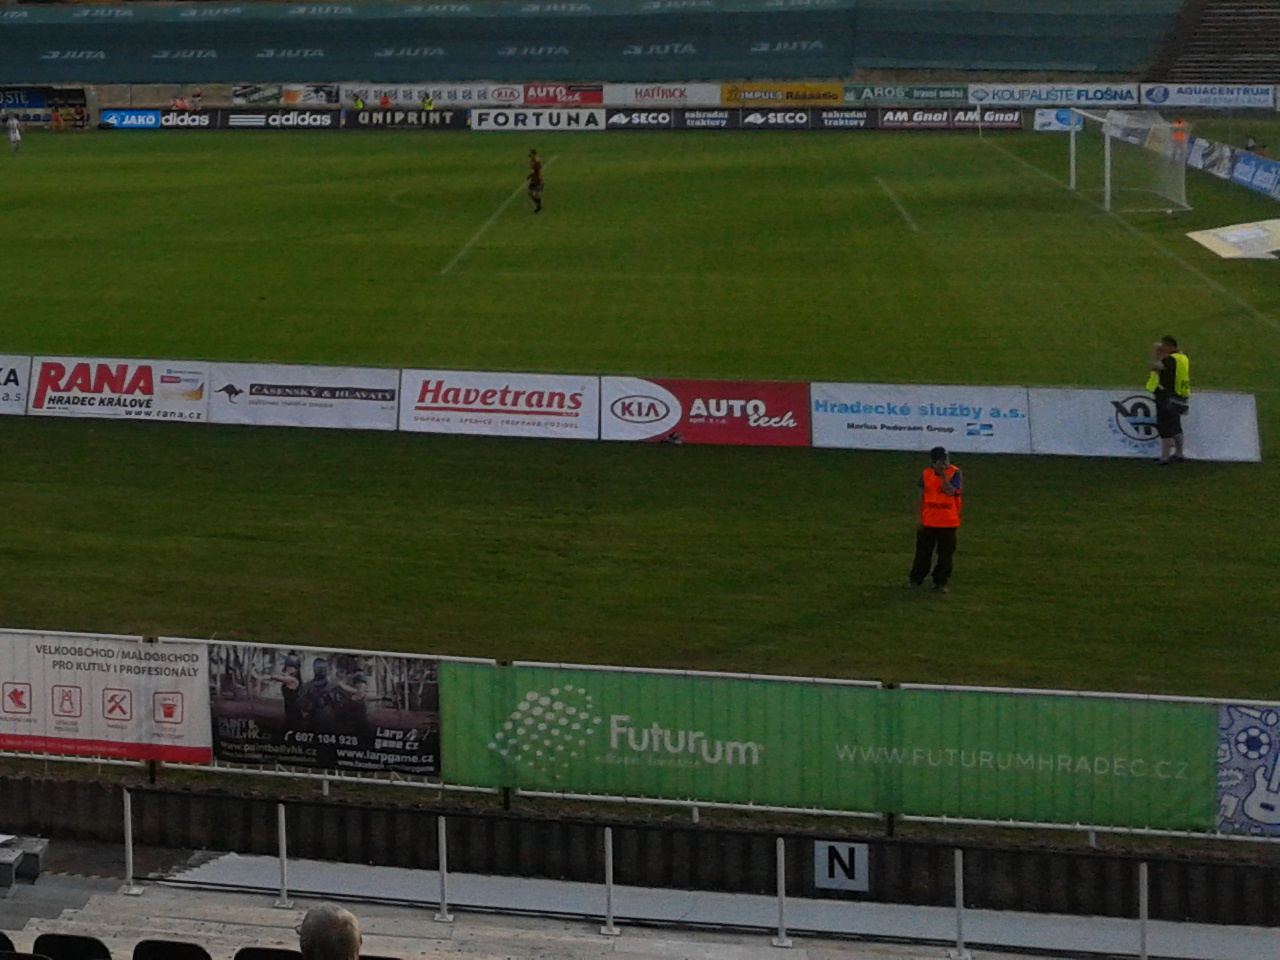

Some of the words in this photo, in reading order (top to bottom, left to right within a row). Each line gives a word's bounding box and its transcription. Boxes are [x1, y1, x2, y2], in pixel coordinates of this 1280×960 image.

[527, 86, 567, 99] AUTO
[1076, 86, 1135, 101] FLOŠNA
[121, 112, 156, 126] JAKO
[268, 110, 332, 127] adidas
[357, 111, 454, 125] UNIPRINT
[476, 111, 601, 128] FORTUNA
[630, 112, 670, 125] SECO
[767, 112, 807, 125] SECO
[882, 111, 909, 122] AM
[912, 110, 948, 122] Gnol
[983, 110, 1020, 122] Gnol
[32, 361, 154, 409] RANA
[1, 390, 25, 403] a.s.
[47, 396, 97, 407] HRADEC
[98, 394, 154, 409] KRÁLOVÉ
[416, 380, 584, 410] Havetrans
[620, 401, 660, 418] KIA
[689, 398, 767, 419] AUTO
[814, 399, 912, 417] Hradecké
[916, 401, 983, 420] služby
[988, 403, 1027, 418] a.s.
[747, 410, 798, 429] tech
[35, 644, 115, 659] VELKOOBCHOD
[121, 650, 200, 663] MALOOBCHOD
[52, 659, 74, 671] PRO
[119, 663, 200, 678] PROFESIONÁLY
[375, 726, 404, 740] Larp
[609, 713, 760, 766] Futurum
[336, 748, 434, 765] www.larpgame.cz
[834, 743, 1189, 781] WWW.FUTURUMHRADEC.CZ
[827, 844, 856, 881] N
